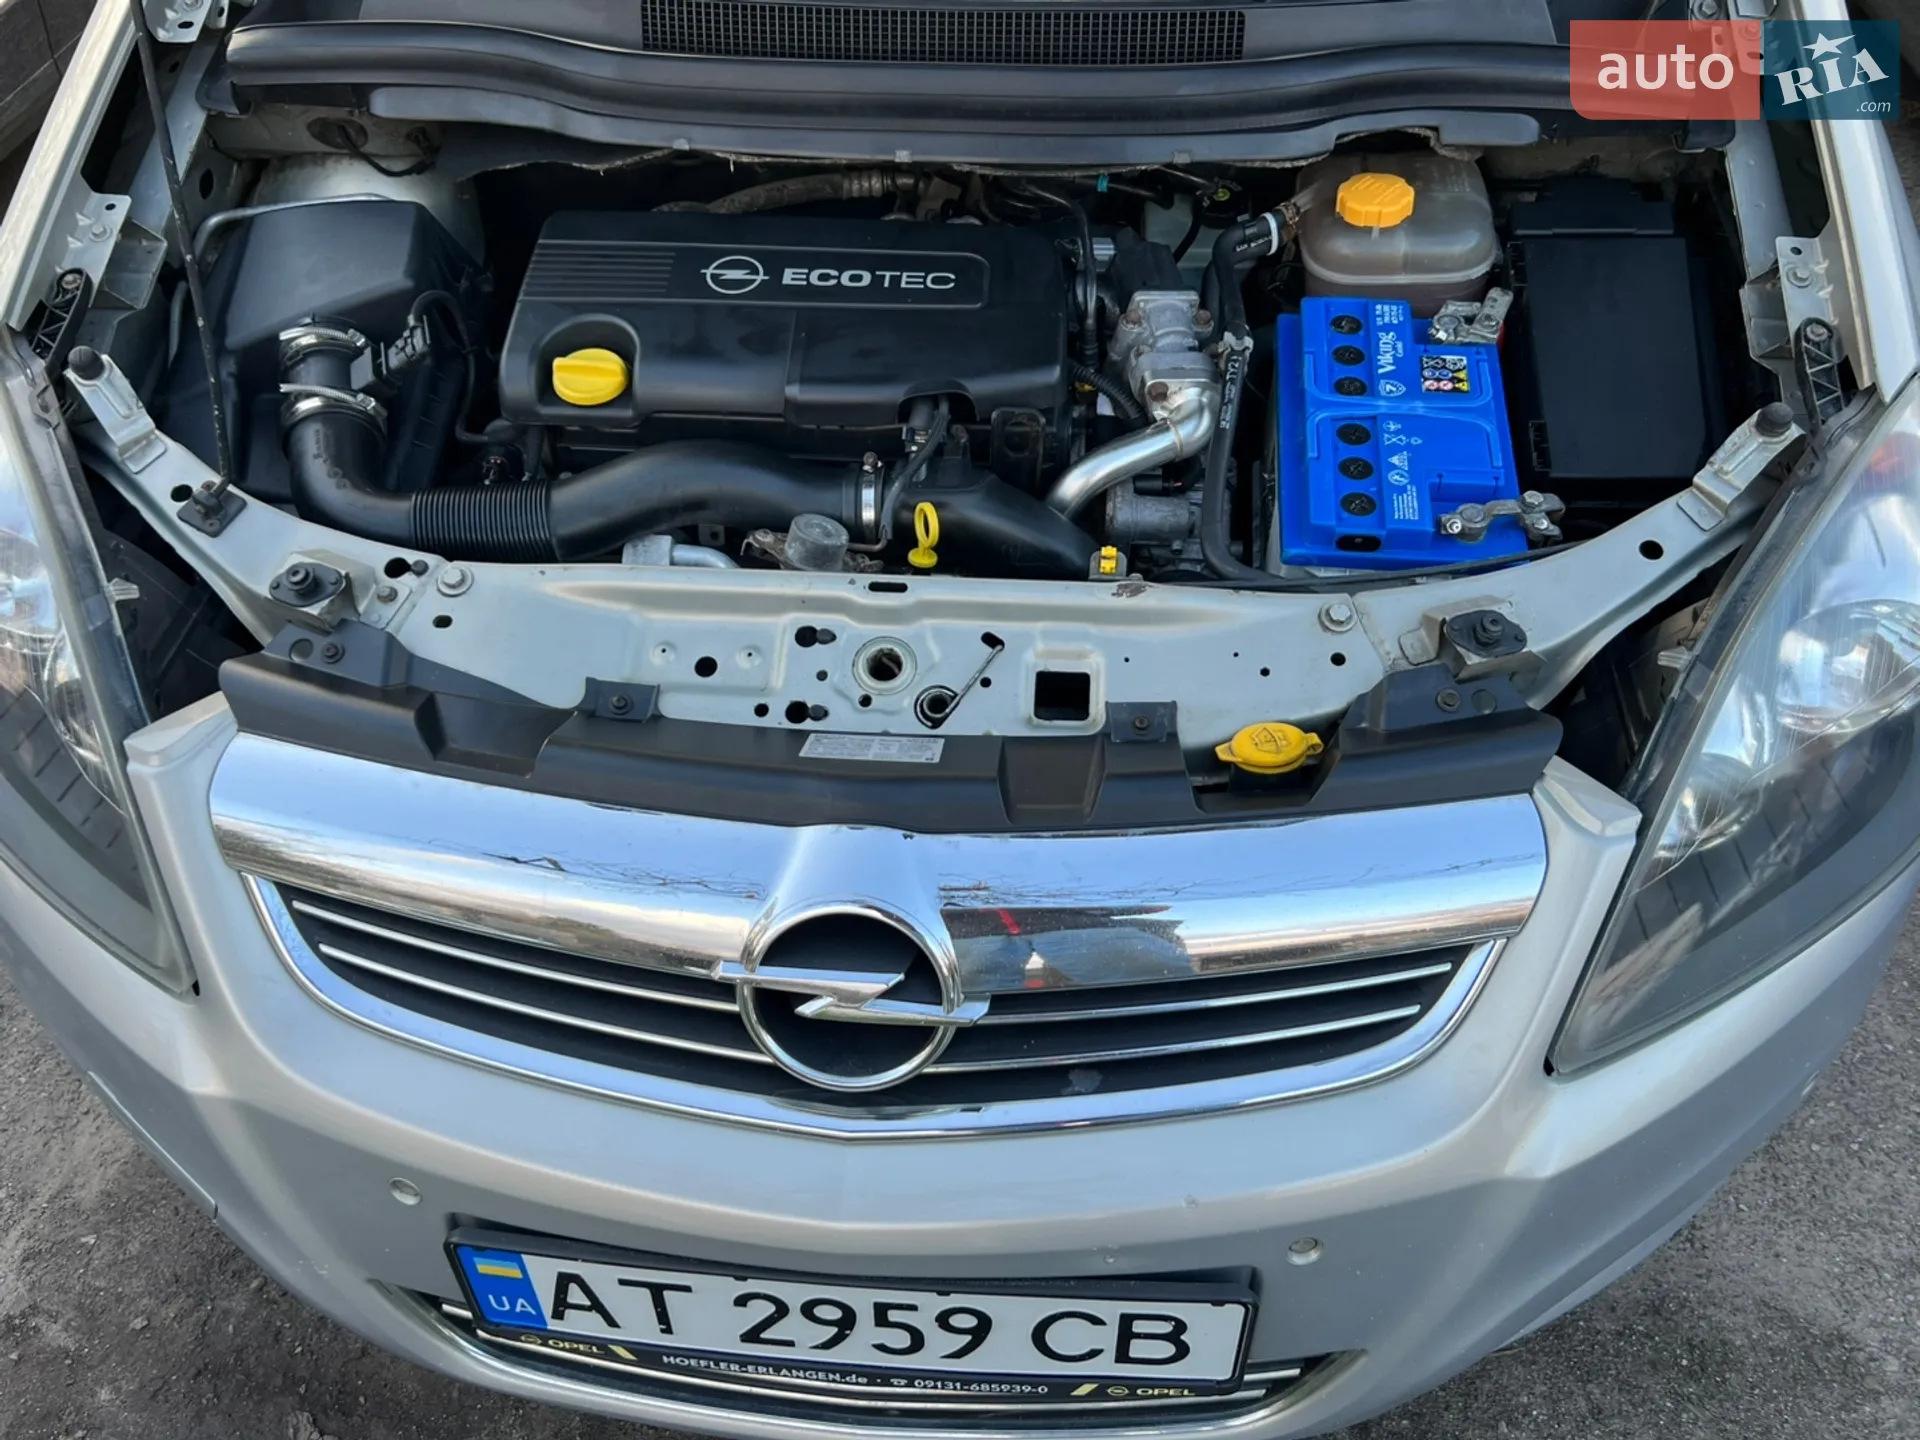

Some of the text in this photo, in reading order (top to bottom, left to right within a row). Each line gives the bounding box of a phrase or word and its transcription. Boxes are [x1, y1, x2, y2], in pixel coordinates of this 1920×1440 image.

[781, 267, 956, 290] ECOTEC
[1377, 331, 1396, 375] Viking
[489, 1293, 536, 1316] UA
[550, 1270, 1191, 1367] AT 2959 CB
[546, 1337, 1196, 1397] OPEL HOEFLER-ERLANGEN.de 09131-685939-0 OPEL
